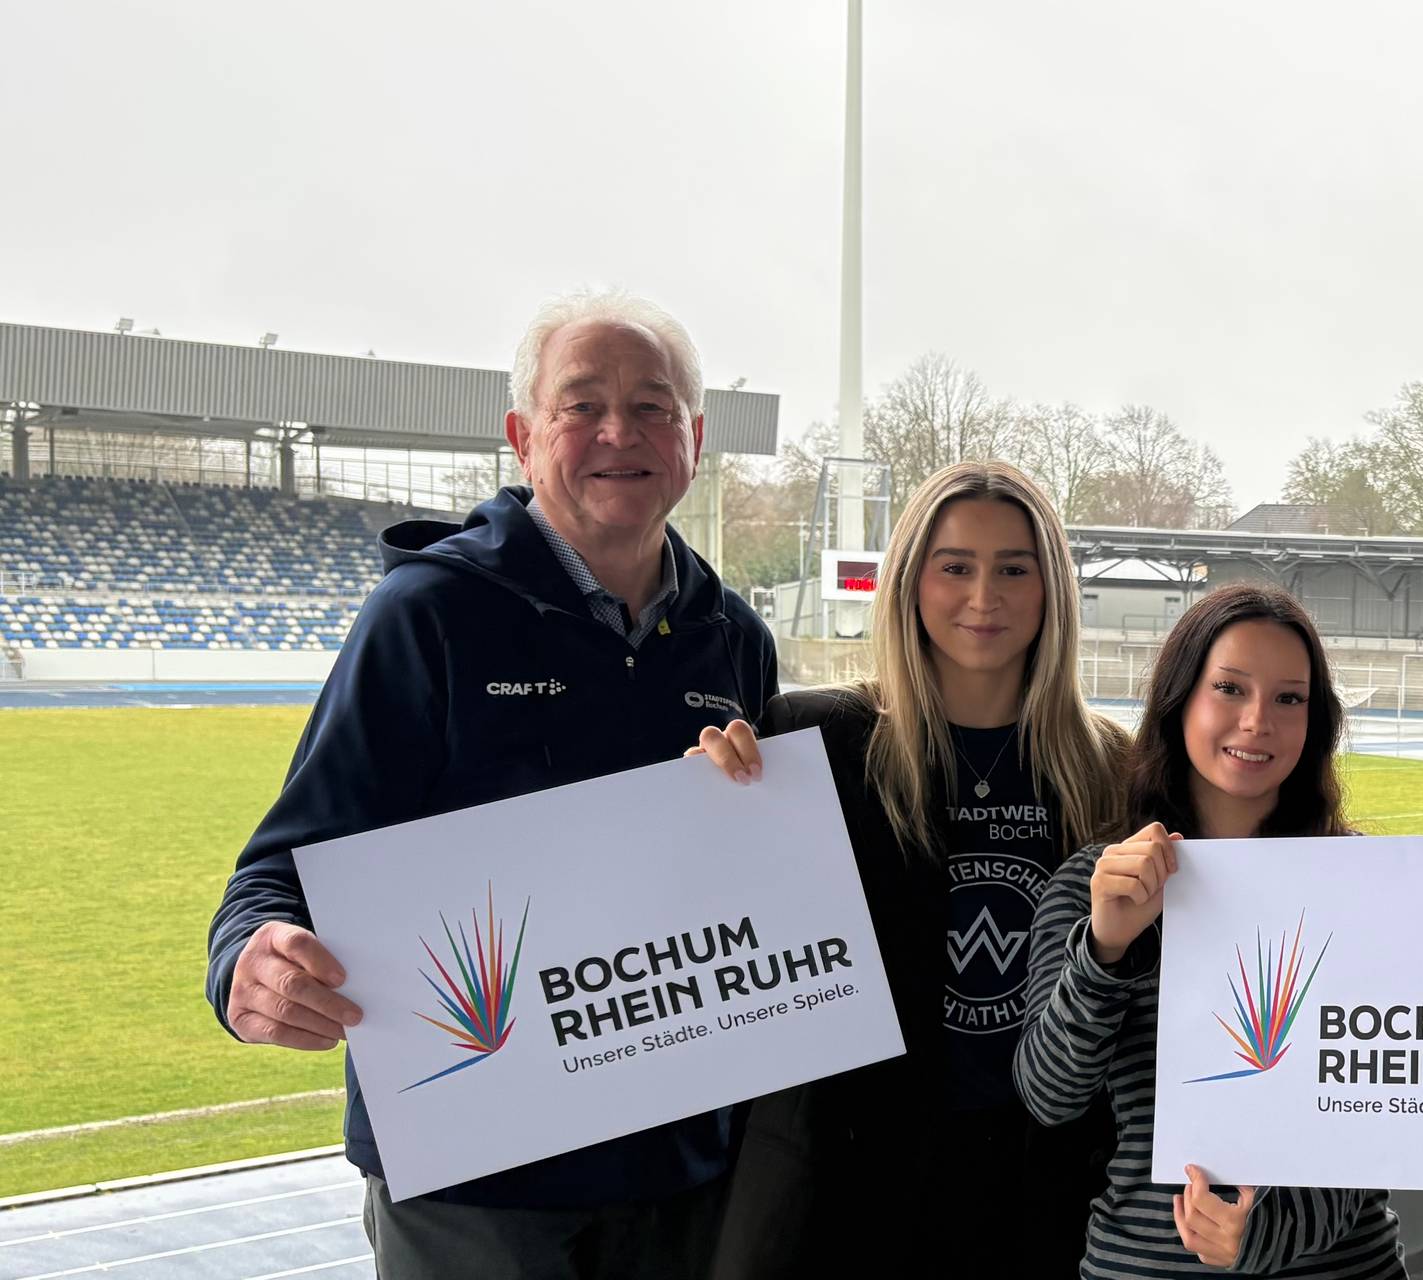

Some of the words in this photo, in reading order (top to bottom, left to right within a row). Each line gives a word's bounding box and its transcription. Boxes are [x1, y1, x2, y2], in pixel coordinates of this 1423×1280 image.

[486, 682, 548, 696] CRAFT
[945, 804, 1048, 821] TADTWER
[948, 860, 1047, 900] TENSCHE
[538, 916, 760, 1005] BOCHUM
[550, 975, 704, 1047] RHEIN
[713, 937, 853, 1002] RUHR
[562, 1045, 637, 1073] Unsere
[641, 1026, 713, 1052] Städte.
[717, 1002, 789, 1030] Unsere
[793, 983, 860, 1011] Spiele.
[1317, 1096, 1383, 1113] Unsere
